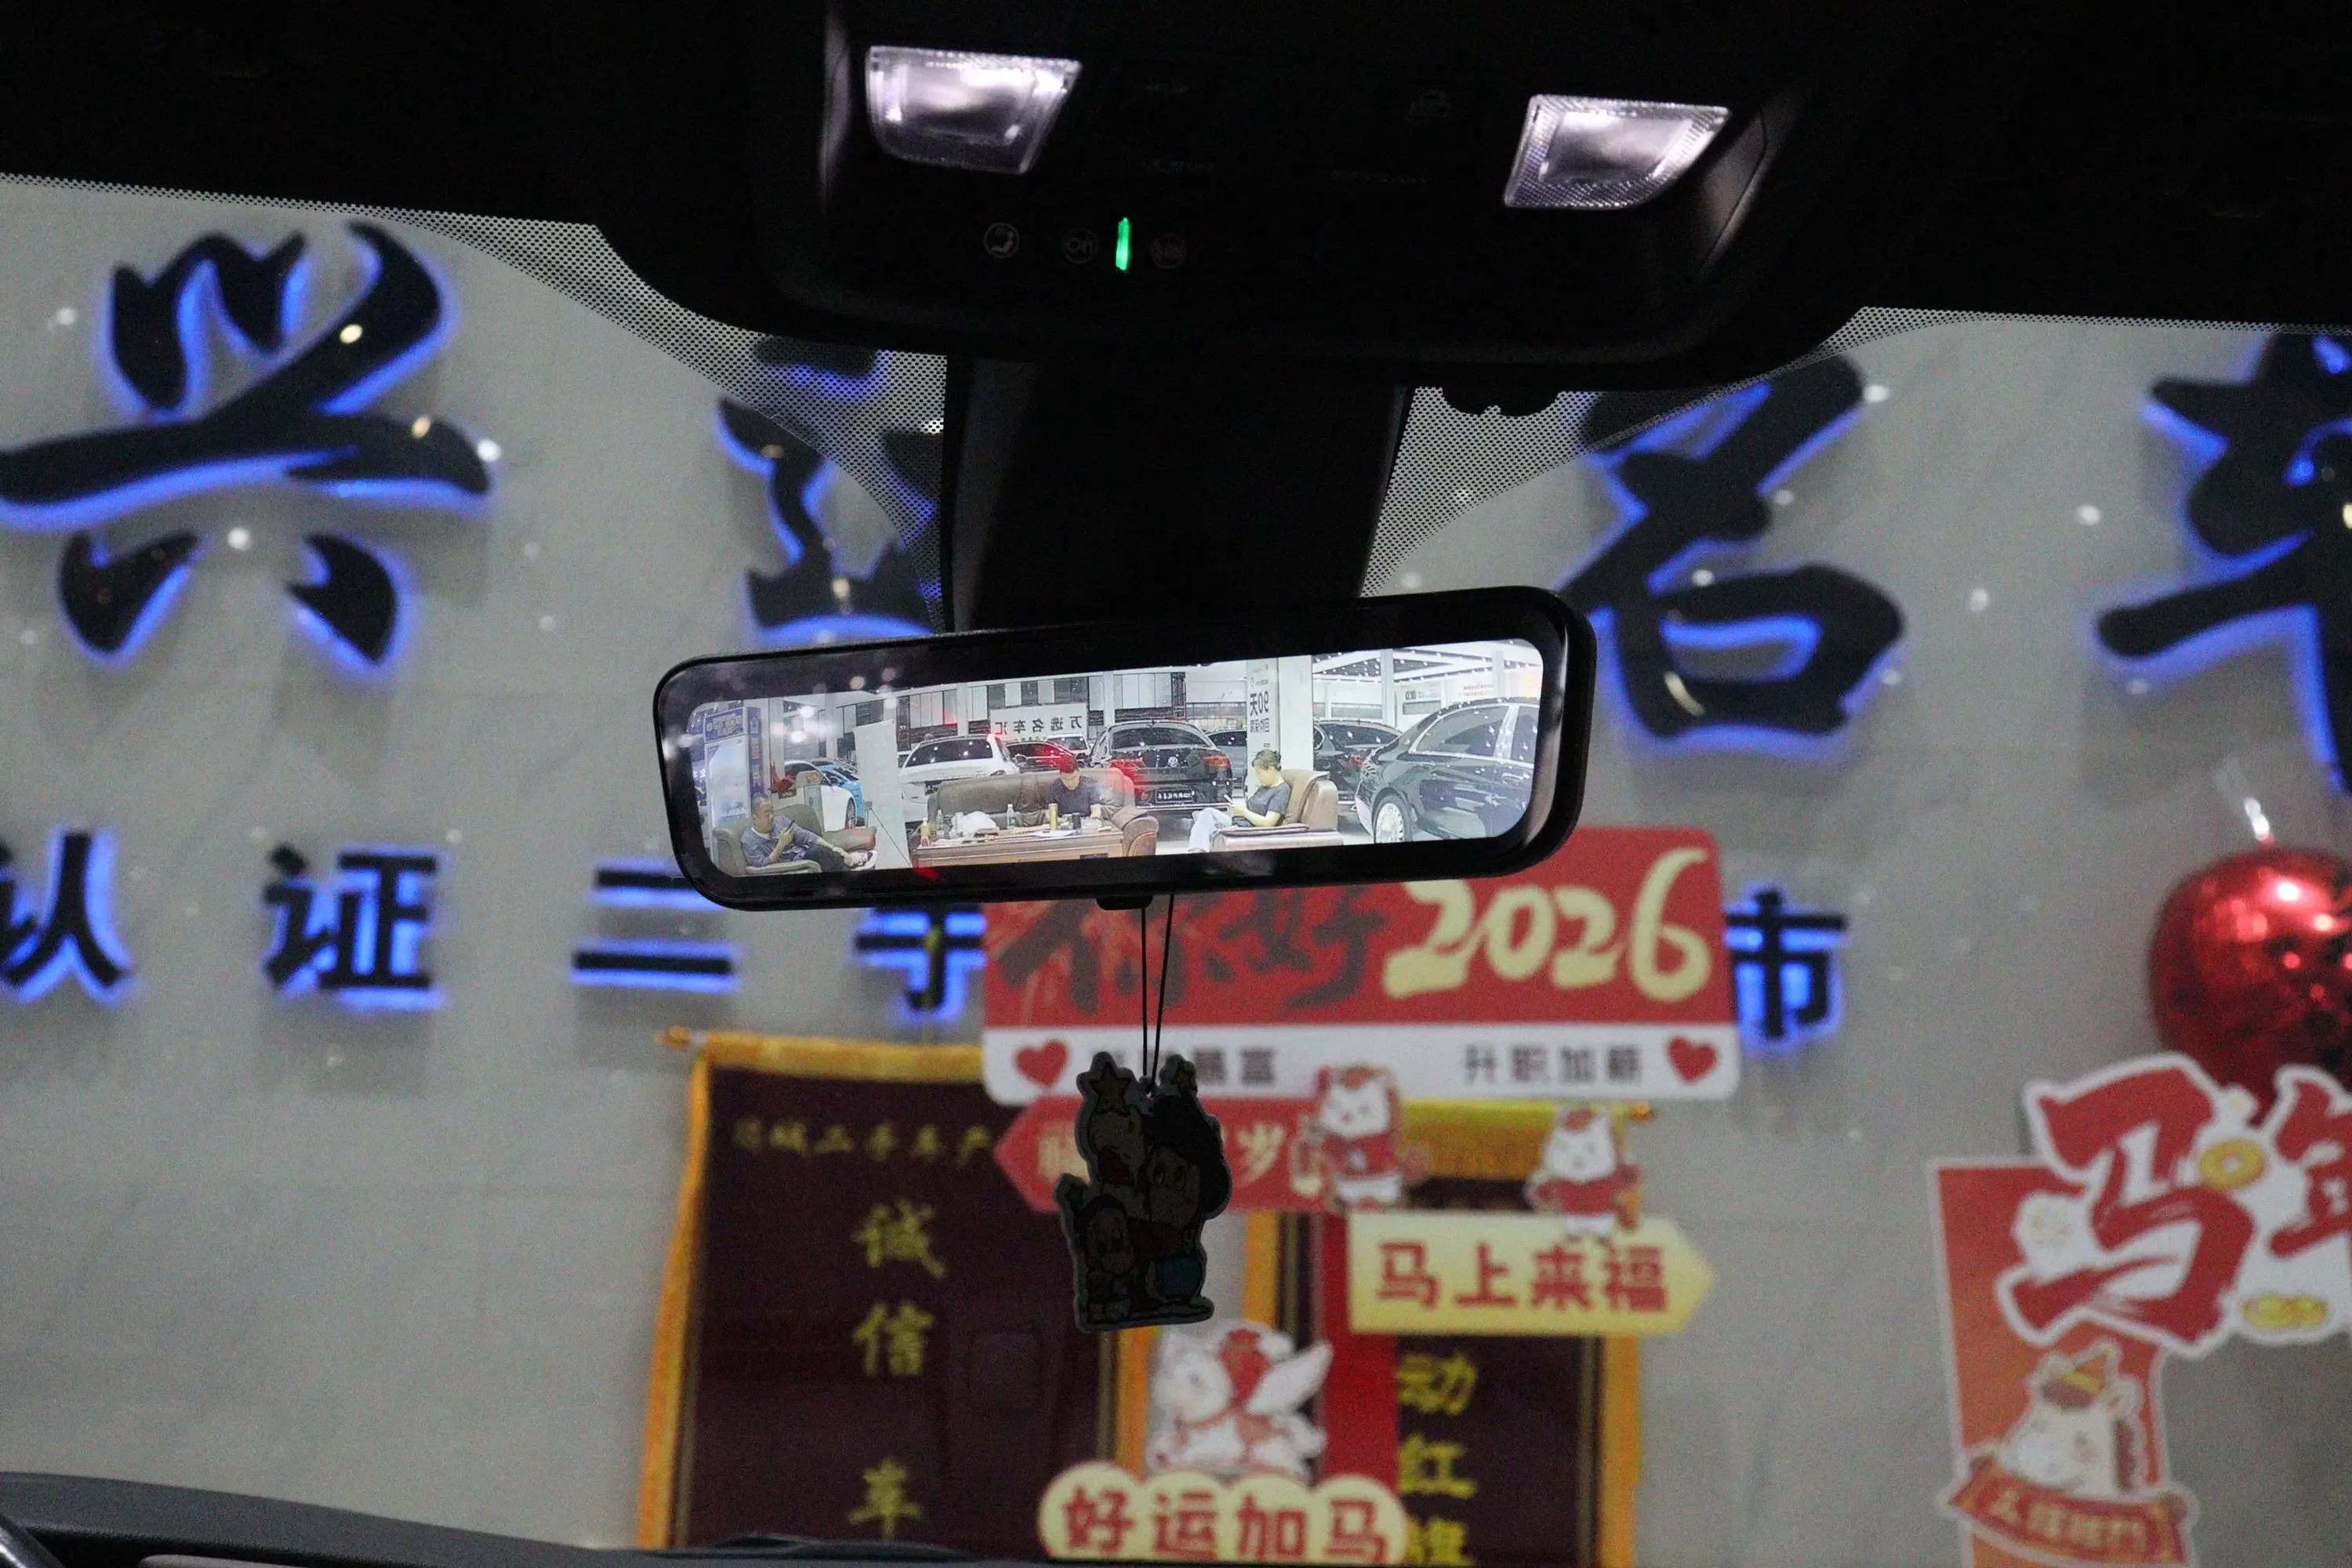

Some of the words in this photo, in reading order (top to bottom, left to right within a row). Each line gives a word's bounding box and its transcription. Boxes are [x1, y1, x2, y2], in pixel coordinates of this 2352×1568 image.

[1377, 1239, 1668, 1312] 马上来福
[1064, 1487, 1388, 1564] 好运加马
